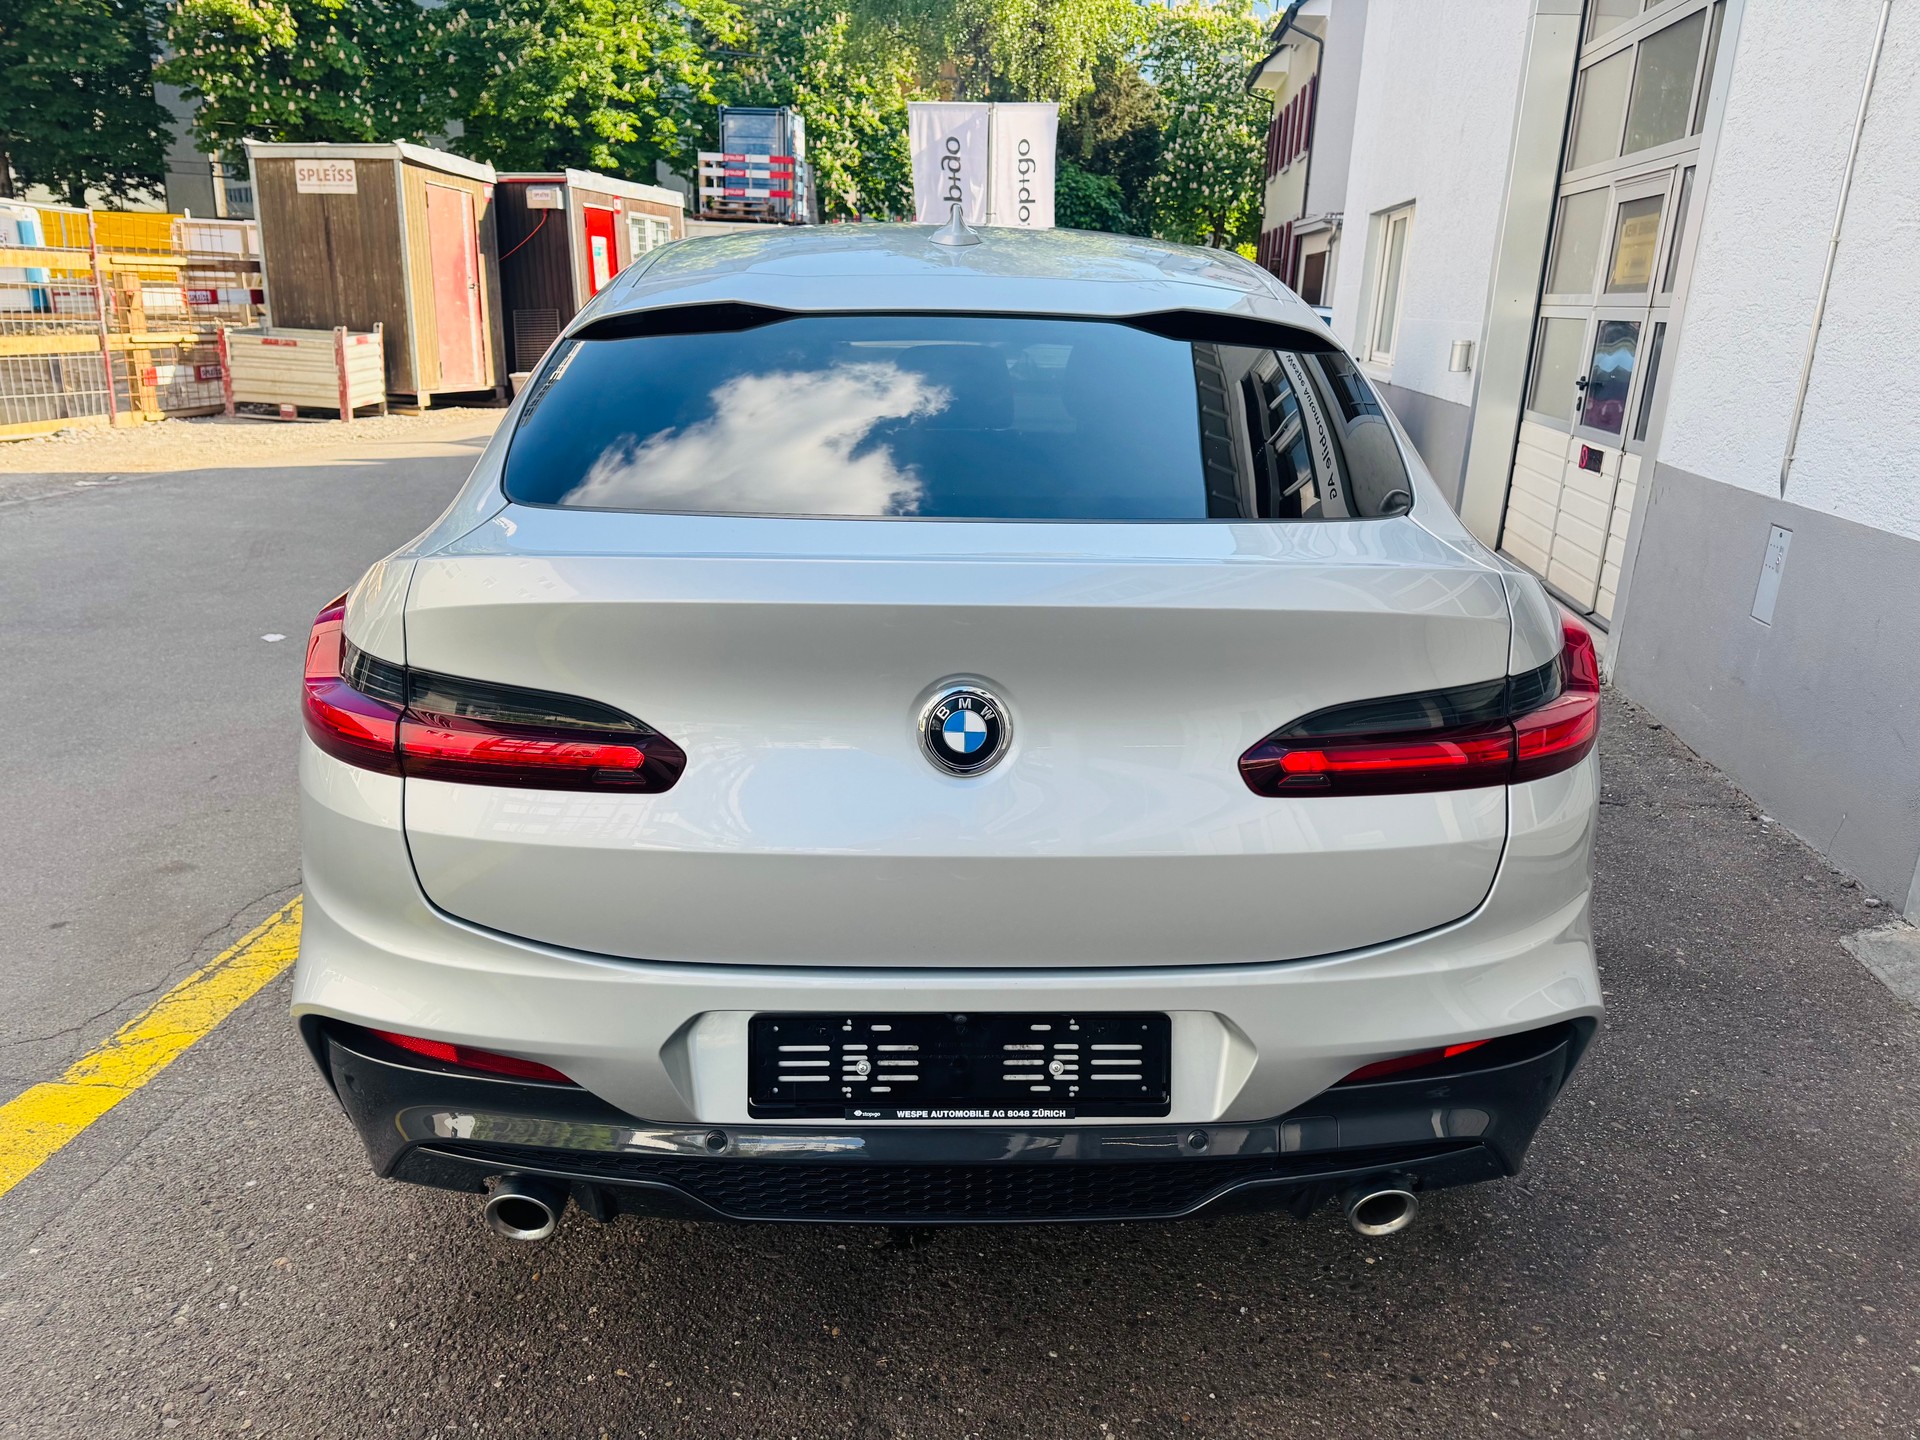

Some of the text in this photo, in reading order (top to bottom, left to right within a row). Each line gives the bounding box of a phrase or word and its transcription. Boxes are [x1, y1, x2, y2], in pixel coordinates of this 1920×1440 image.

[1018, 138, 1036, 225] op+go
[936, 698, 995, 721] BMW
[896, 1110, 928, 1118] WESPE
[930, 1110, 990, 1118] AUTOMOBILE
[992, 1110, 1005, 1118] AG
[1007, 1110, 1030, 1118] 8048
[1032, 1108, 1066, 1118] ZÜRICH
